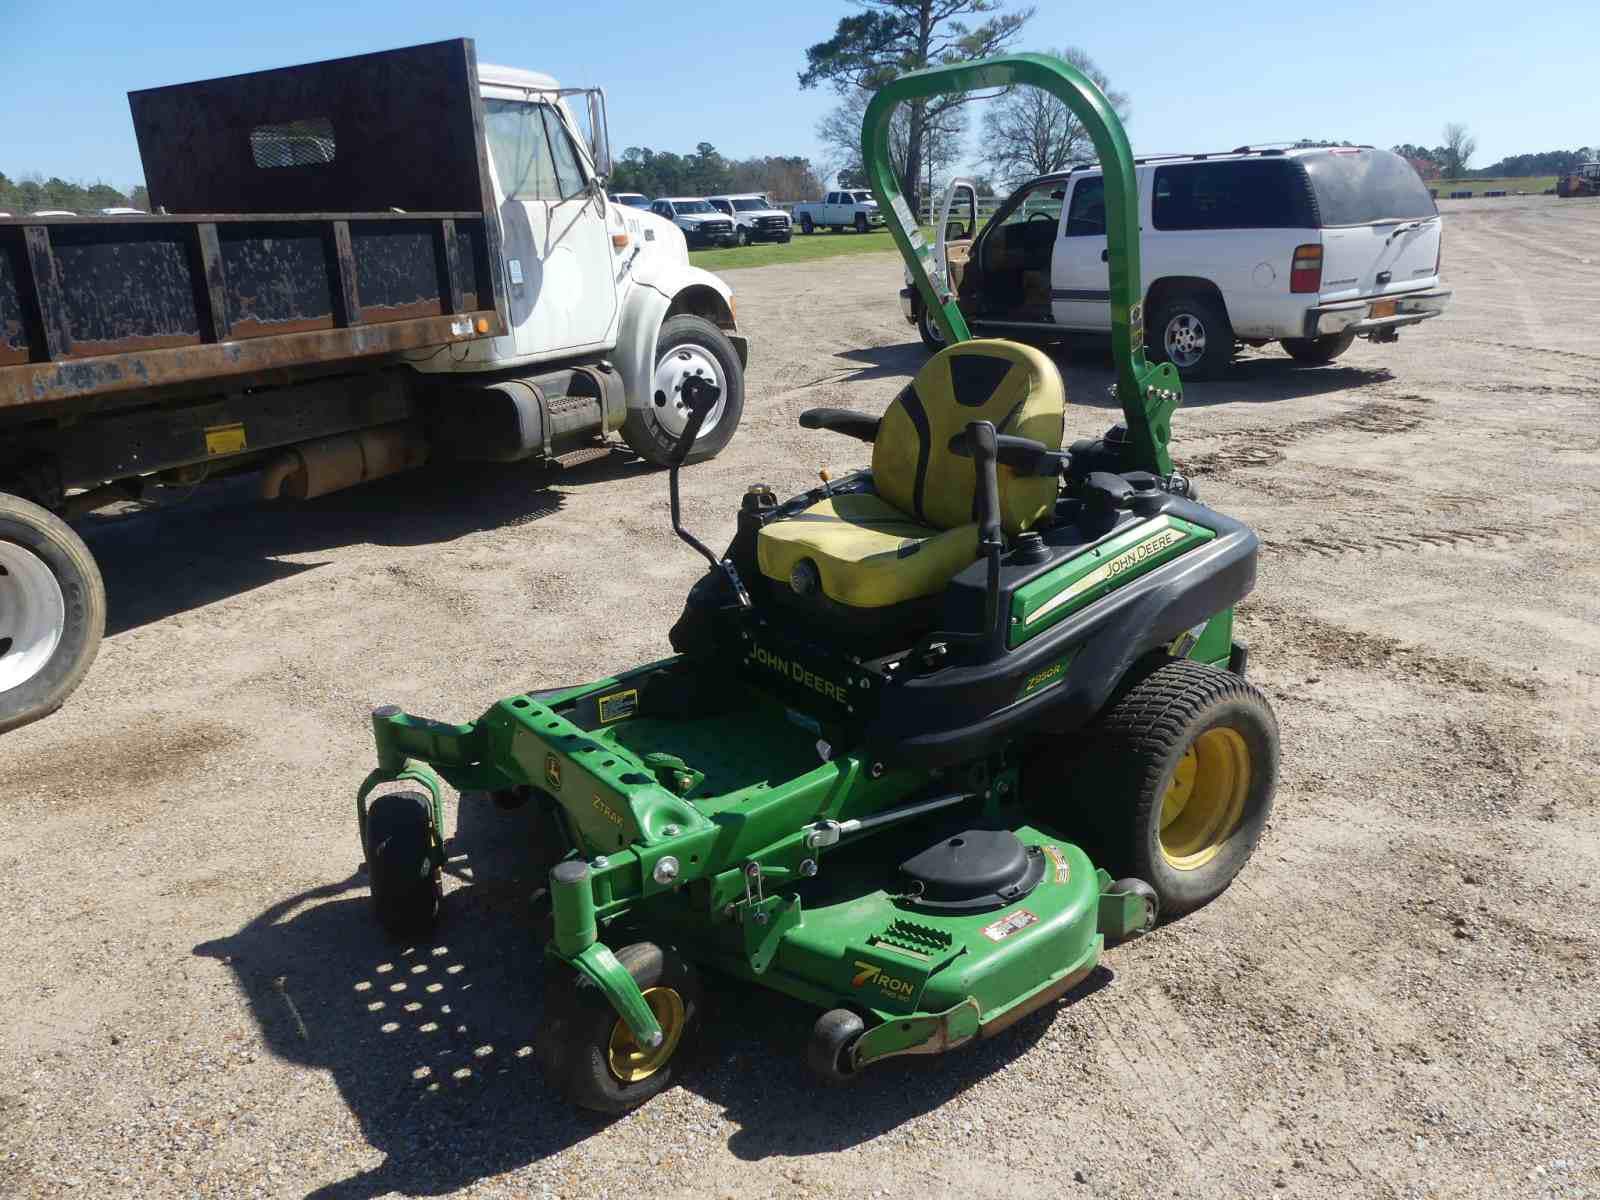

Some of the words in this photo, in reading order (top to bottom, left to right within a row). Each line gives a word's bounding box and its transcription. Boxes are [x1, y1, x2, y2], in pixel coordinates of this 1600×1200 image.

[1105, 551, 1136, 577] JOHN
[1137, 533, 1173, 559] DEERE
[750, 641, 789, 676] JOHN
[792, 662, 848, 703] DEERE
